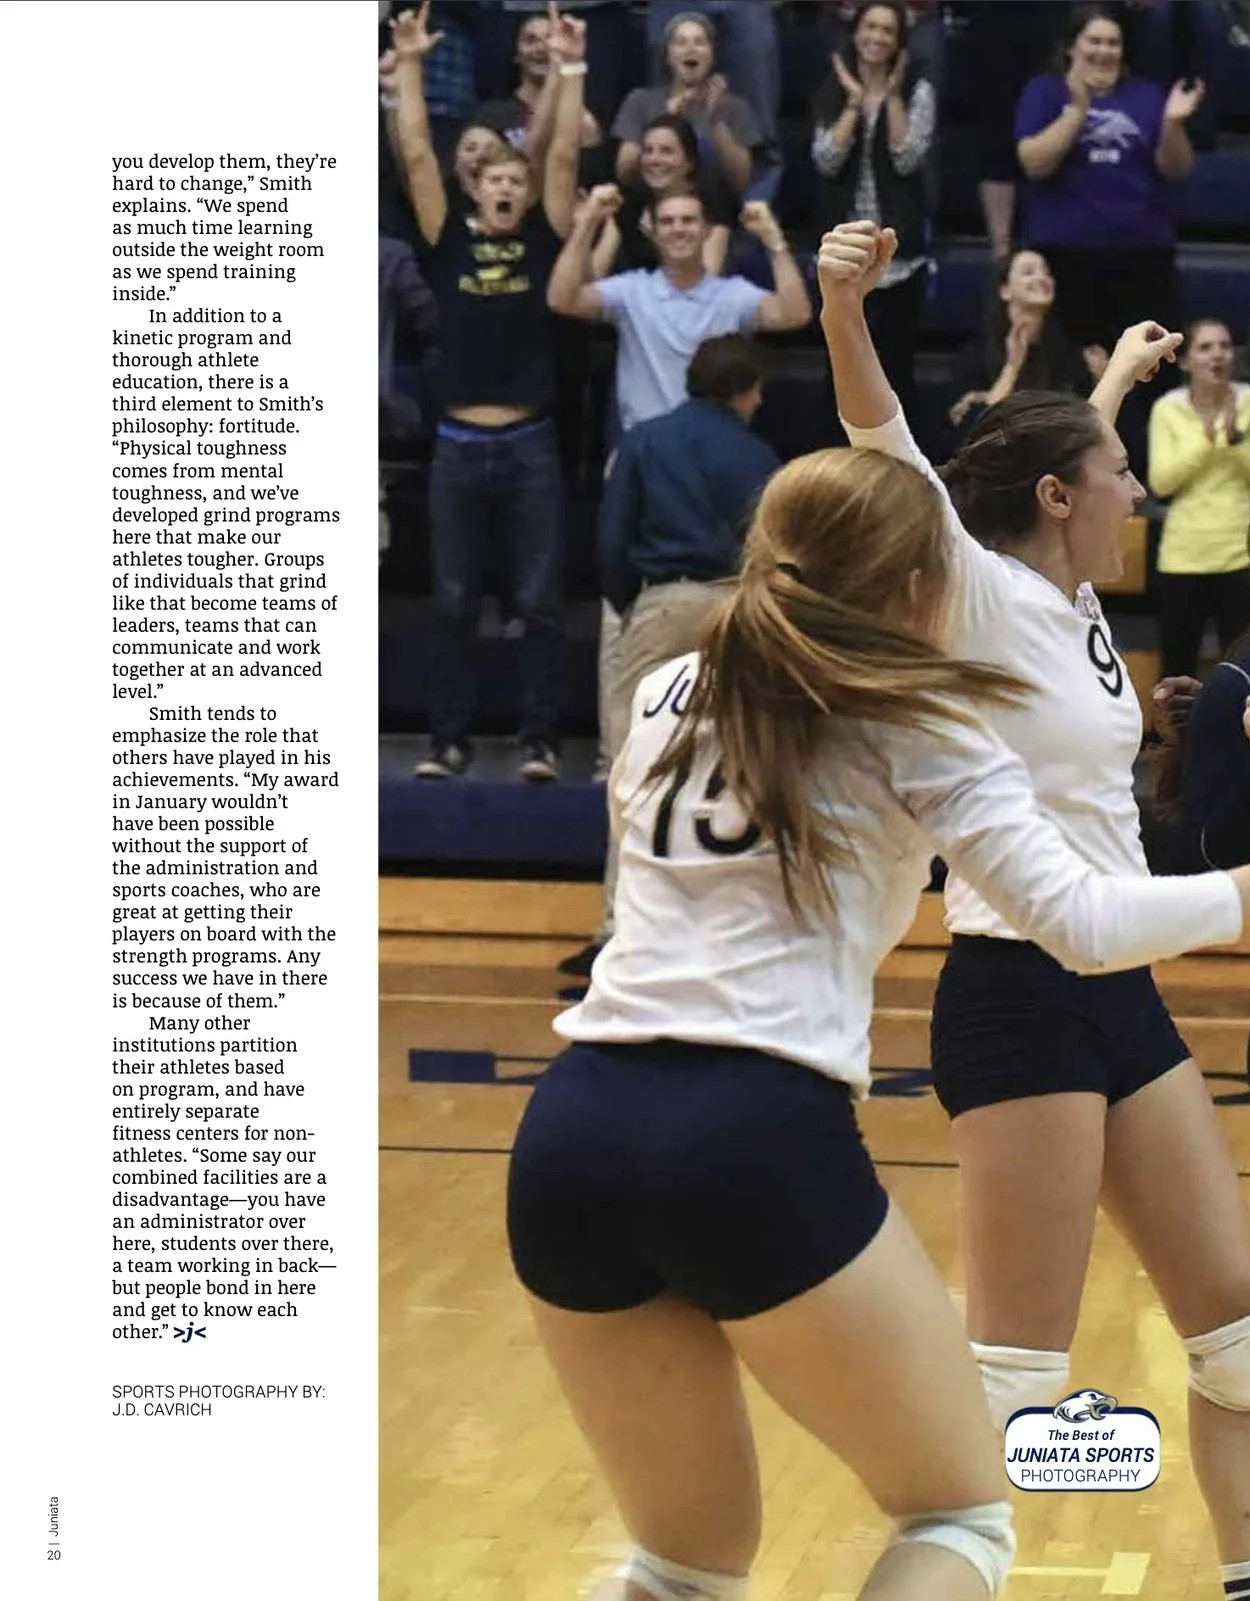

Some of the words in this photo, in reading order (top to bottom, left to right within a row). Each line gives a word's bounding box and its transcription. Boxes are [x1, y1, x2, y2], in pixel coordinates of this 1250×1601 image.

[111, 157, 144, 173] you
[148, 153, 215, 173] develop
[218, 152, 271, 172] them,
[275, 152, 337, 173] they’re
[112, 223, 132, 235] as
[136, 219, 188, 235] much
[191, 219, 233, 235] time
[237, 219, 313, 239] learning
[112, 285, 177, 301] inside.”
[112, 329, 173, 346] kinetic
[177, 333, 254, 350] program
[258, 329, 292, 346] and
[111, 395, 157, 412] third
[161, 395, 233, 412] element
[236, 397, 254, 412] to
[259, 395, 324, 412] Smith’s
[112, 466, 168, 479] comes
[172, 462, 216, 479] from
[220, 462, 284, 479] mental
[112, 528, 151, 545] here
[155, 528, 193, 545] that
[197, 528, 247, 545] make
[251, 532, 282, 545] our
[112, 594, 145, 611] like
[149, 594, 186, 611] that
[190, 594, 257, 611] become
[261, 596, 316, 611] teams
[321, 594, 338, 611] of
[112, 639, 233, 655] communicate
[238, 638, 272, 655] and
[275, 638, 321, 655] work
[1087, 623, 1123, 698] 9
[149, 705, 203, 721] Smith
[206, 705, 255, 721] tends
[259, 706, 277, 721] to
[112, 771, 239, 787] achievements.
[243, 771, 280, 791] “My
[283, 771, 340, 787] award
[111, 837, 182, 854] without
[186, 837, 215, 854] the
[219, 839, 287, 857] support
[291, 837, 309, 854] of
[112, 883, 166, 901] sports
[171, 881, 245, 900] coaches,
[249, 881, 288, 898] who
[292, 885, 321, 898] are
[112, 947, 188, 968] strength
[191, 951, 282, 968] programs.
[286, 949, 321, 968] Any
[149, 1016, 200, 1035] Many
[204, 1014, 251, 1031] other
[112, 1084, 134, 1097] on
[138, 1084, 220, 1101] program,
[224, 1080, 259, 1097] and
[263, 1080, 305, 1097] have
[112, 1146, 187, 1163] athletes.
[192, 1147, 248, 1163] “Some
[252, 1150, 282, 1167] say
[286, 1150, 317, 1163] our
[112, 1190, 280, 1211] disadvantage—you
[284, 1191, 326, 1207] have
[112, 1235, 156, 1254] here,
[161, 1235, 237, 1251] students
[241, 1239, 279, 1251] over
[282, 1235, 334, 1254] there,
[112, 1261, 123, 1273] a
[127, 1258, 173, 1273] team
[176, 1257, 251, 1277] working
[255, 1257, 274, 1273] in
[277, 1257, 337, 1273] back—
[112, 1323, 169, 1340] other.”
[112, 1384, 175, 1399] SPORTS
[178, 1384, 298, 1399] PHOTOGRAPHY
[302, 1384, 326, 1399] BY:
[112, 1402, 140, 1416] J.D.
[144, 1402, 212, 1416] CAVRICH
[48, 1496, 59, 1537] Juniata
[47, 1549, 61, 1561] 20
